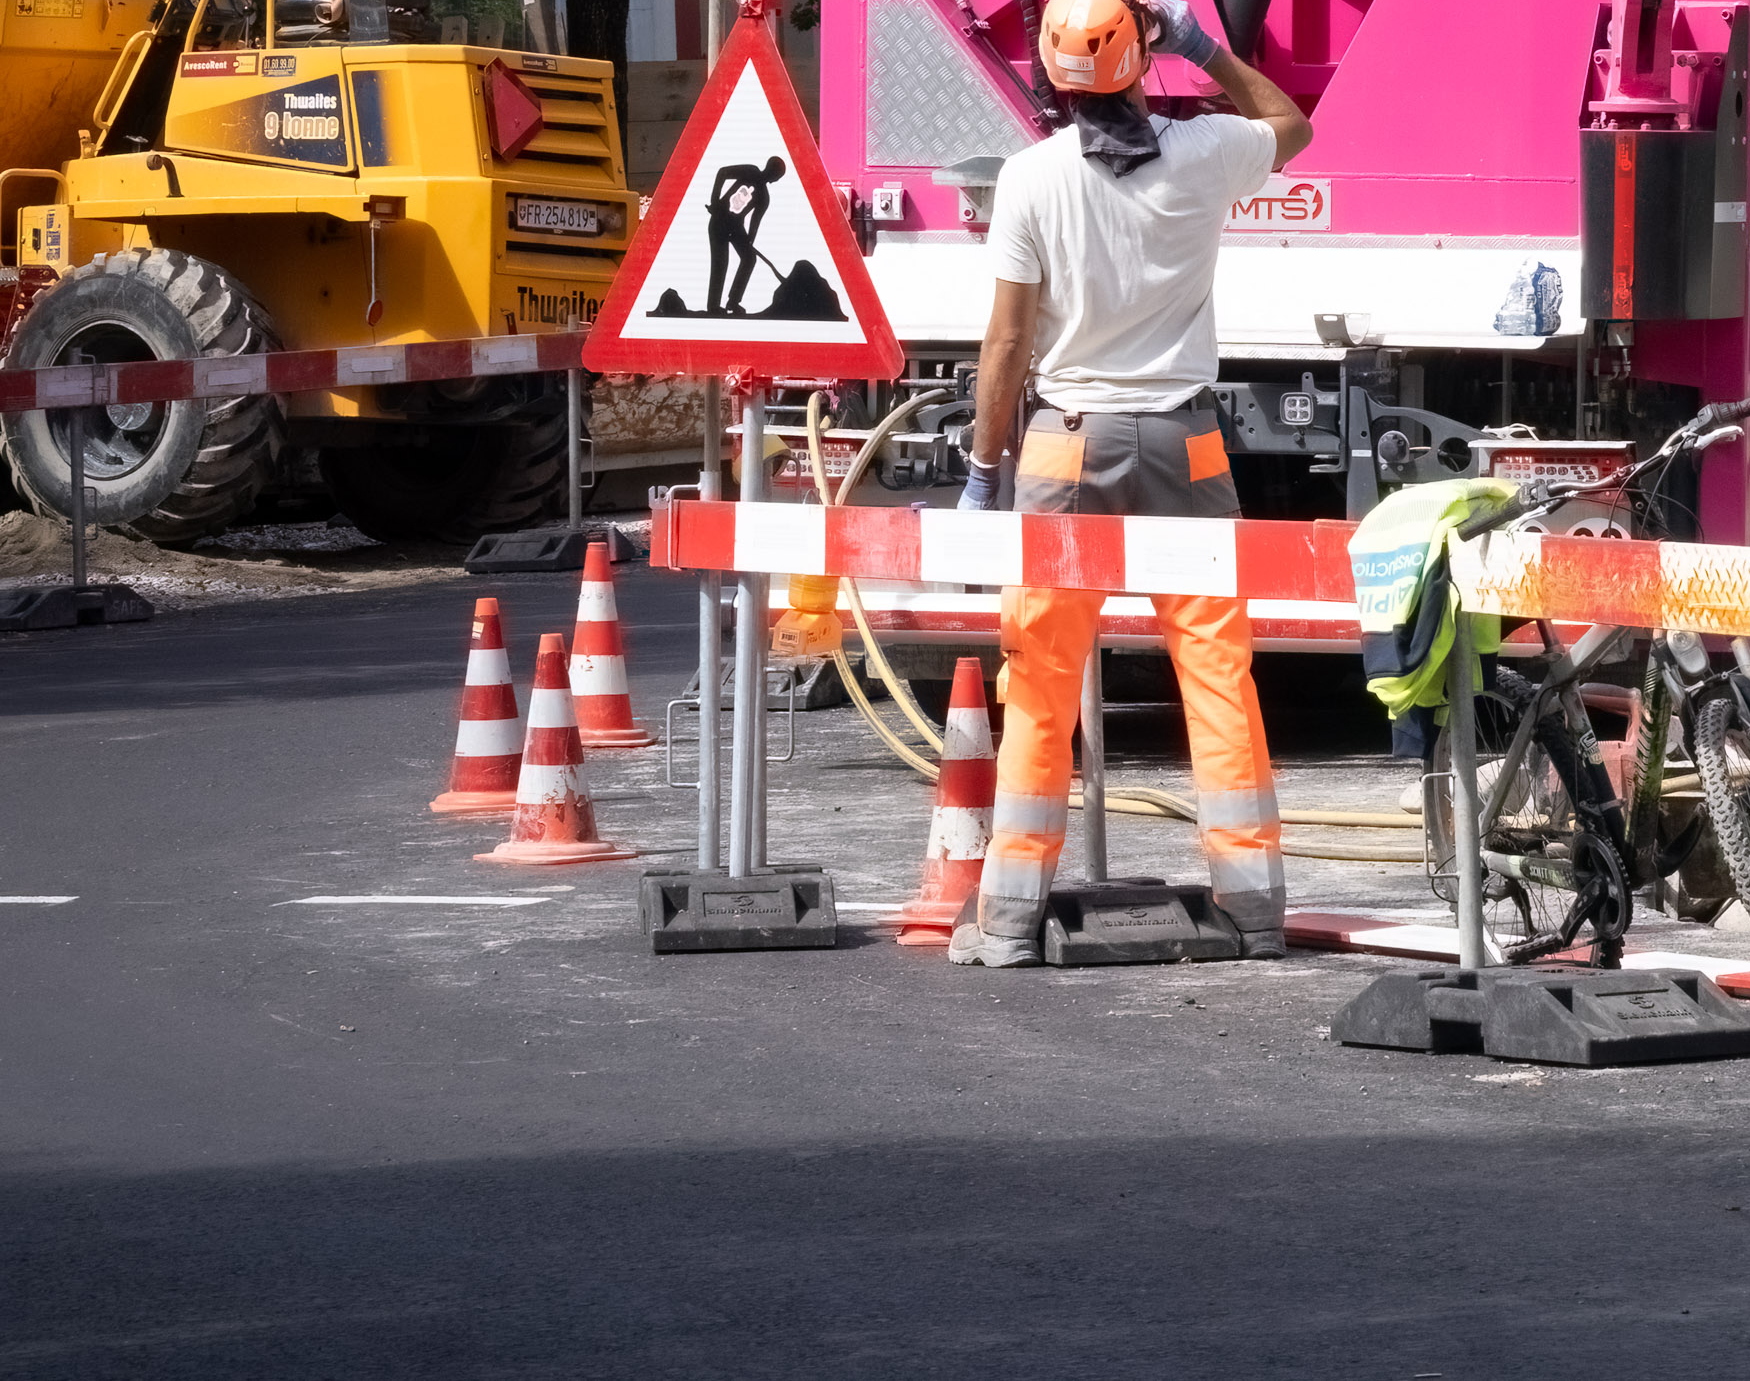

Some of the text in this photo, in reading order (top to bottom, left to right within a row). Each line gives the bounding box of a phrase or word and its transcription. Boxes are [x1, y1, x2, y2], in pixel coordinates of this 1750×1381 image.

[183, 60, 228, 71] AvescoRent
[284, 93, 337, 109] Thwaites
[264, 111, 339, 140] 9 tonne
[1231, 197, 1308, 220] MTS
[517, 286, 606, 325] Thwaite
